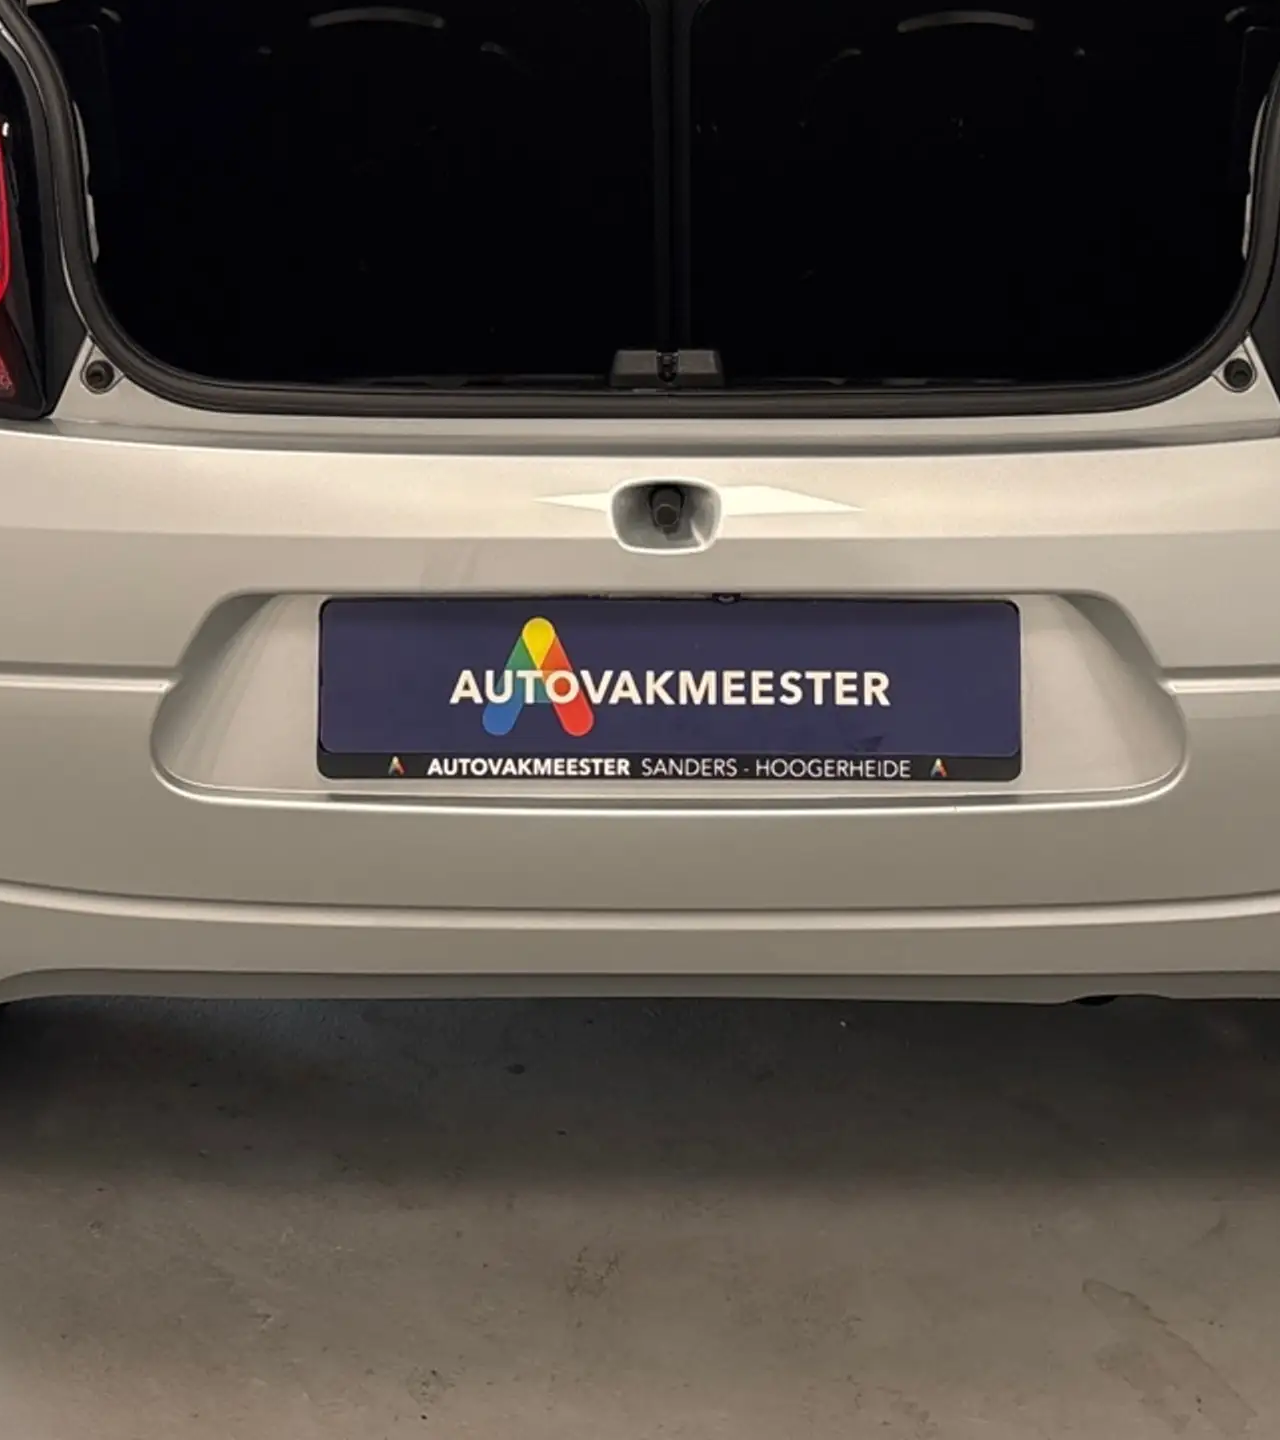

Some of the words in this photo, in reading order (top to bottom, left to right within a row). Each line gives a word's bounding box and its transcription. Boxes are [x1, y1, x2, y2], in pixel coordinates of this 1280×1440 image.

[449, 669, 891, 707] AUTOVAKMEESTER
[427, 757, 631, 778] AUTOVAKMEESTER
[641, 758, 738, 778] SANDERS
[755, 759, 911, 779] HOOGERHEIDE
